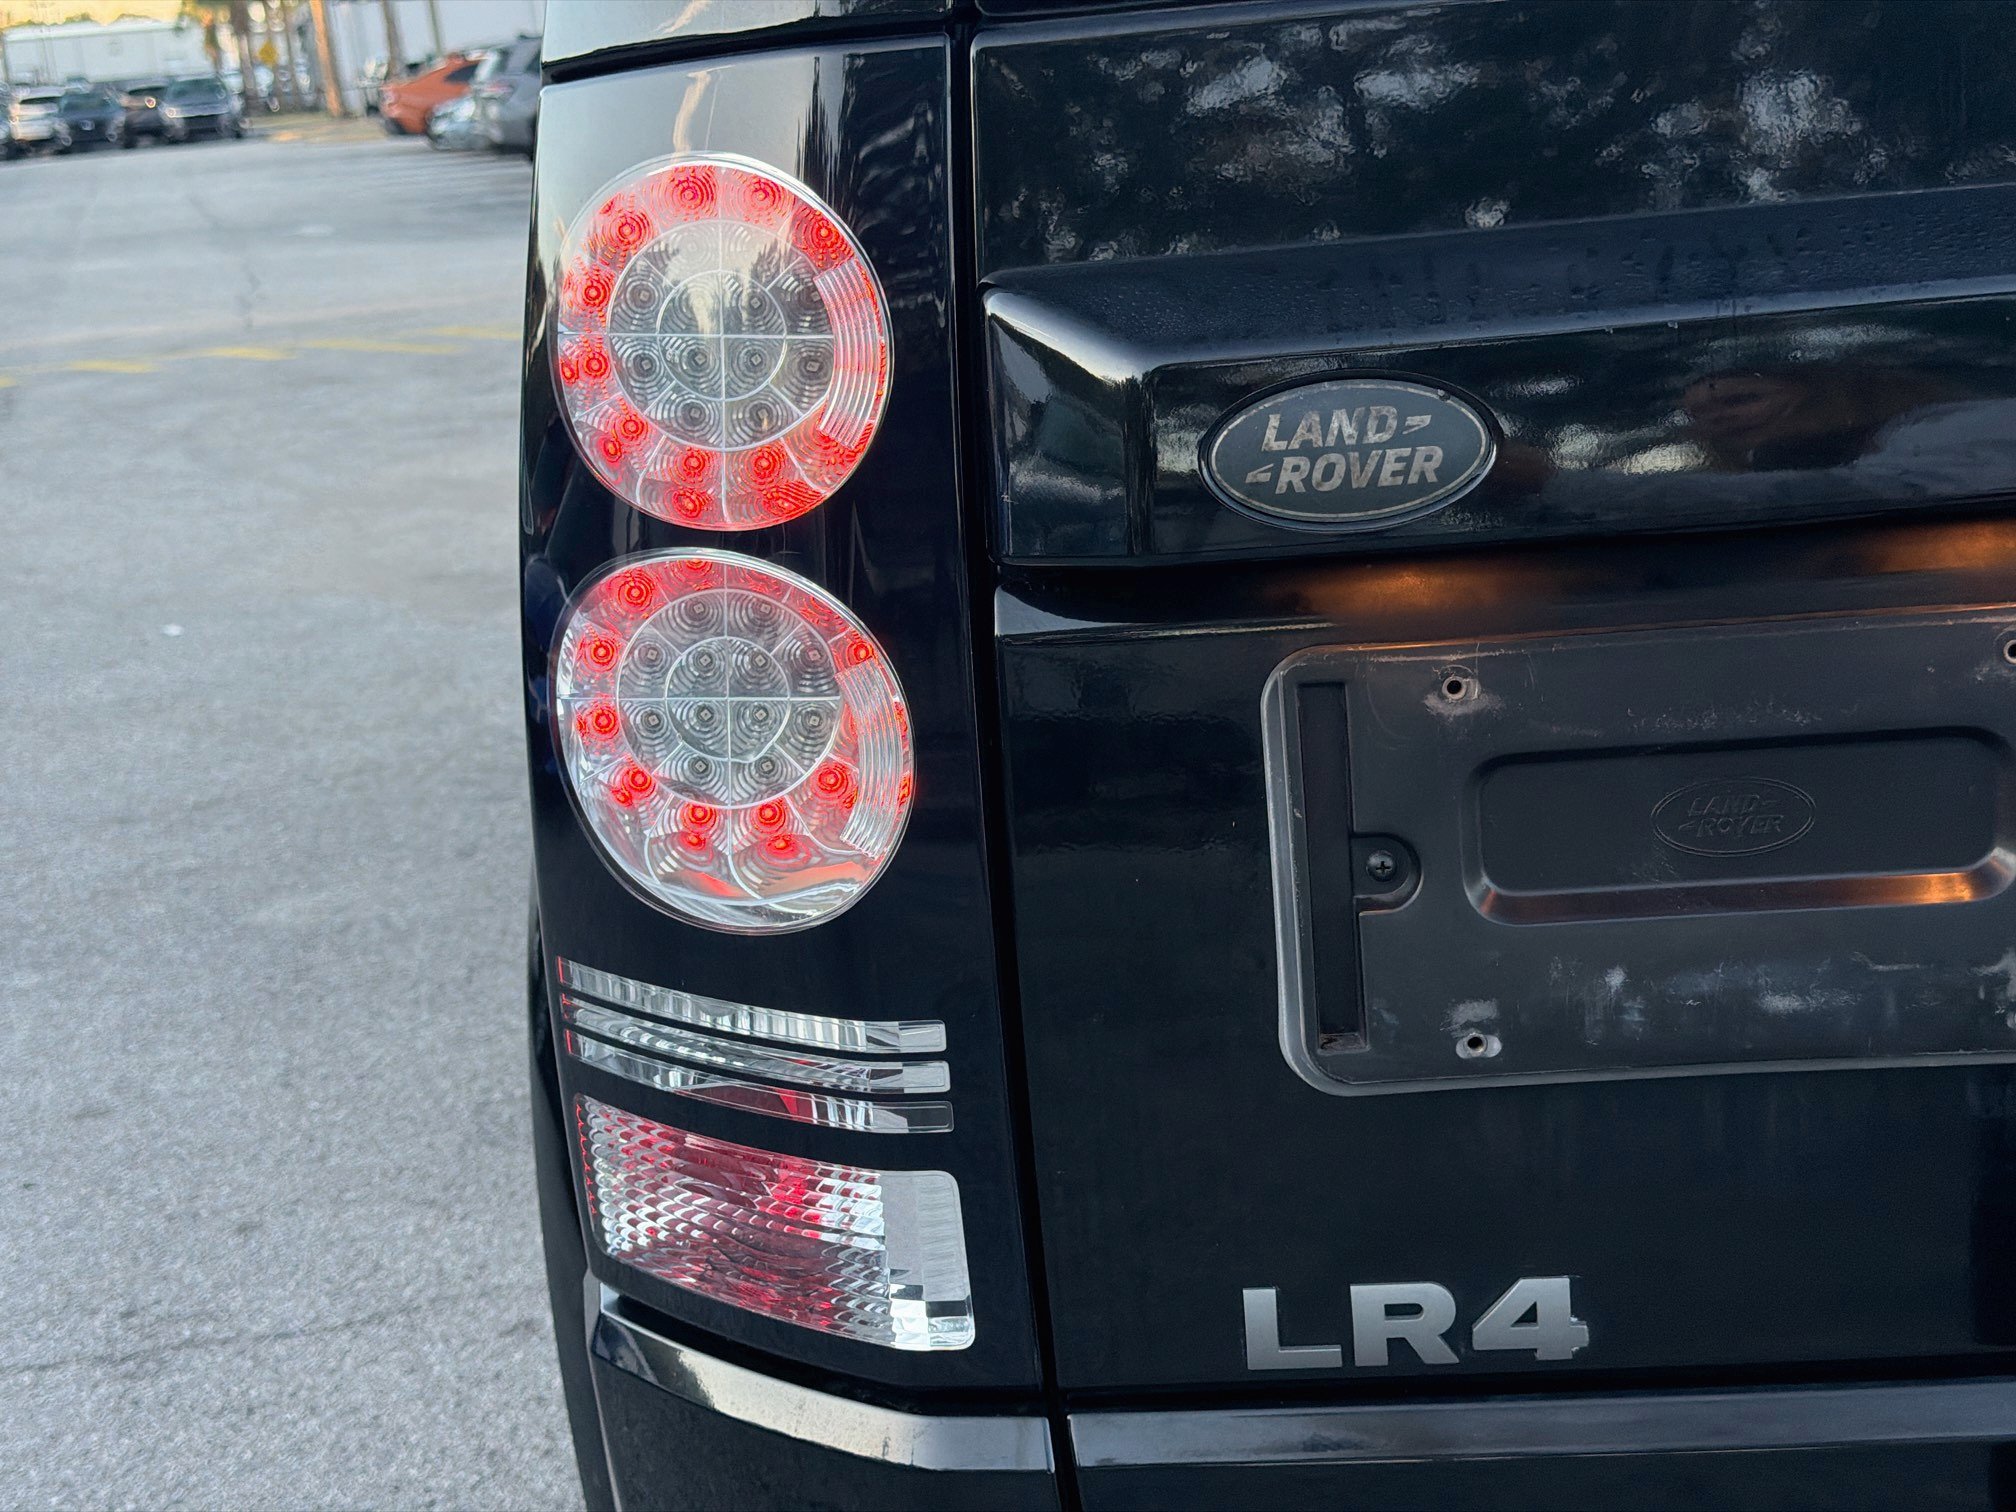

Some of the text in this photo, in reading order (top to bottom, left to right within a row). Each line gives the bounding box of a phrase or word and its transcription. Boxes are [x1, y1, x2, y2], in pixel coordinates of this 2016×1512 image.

[1261, 405, 1398, 452] LAND
[1275, 445, 1444, 495] ROVER
[1688, 794, 1760, 817] LAND
[1697, 814, 1785, 837] ROVER
[1242, 1275, 1590, 1371] LR4
